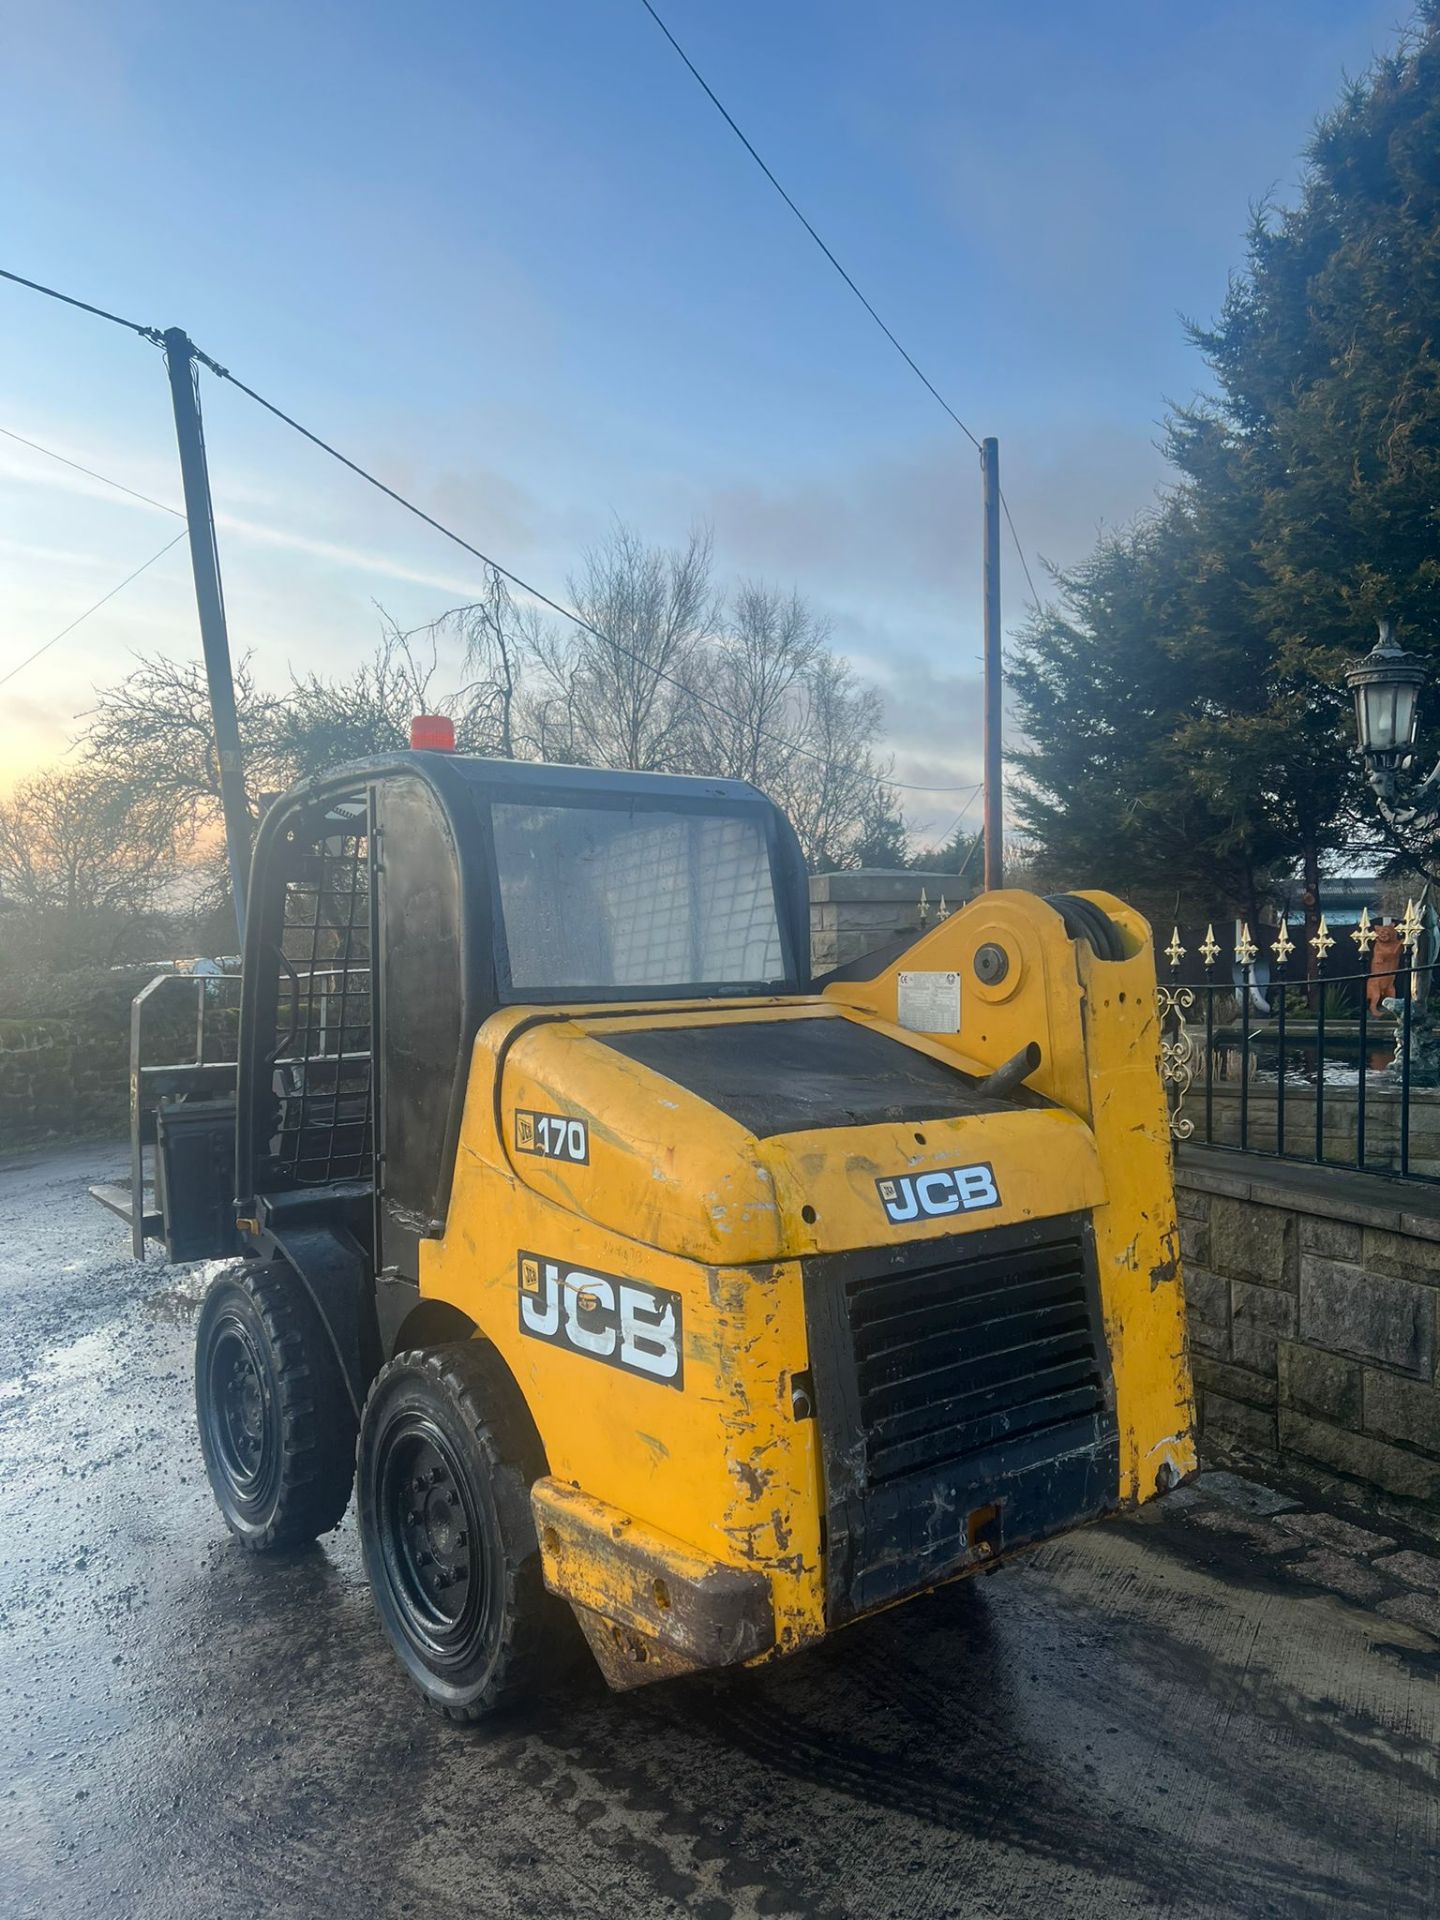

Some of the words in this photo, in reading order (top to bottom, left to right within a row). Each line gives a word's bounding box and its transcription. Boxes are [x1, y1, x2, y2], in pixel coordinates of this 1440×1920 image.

[538, 1117, 586, 1160] 170
[886, 1166, 998, 1220] JCB
[521, 1264, 678, 1378] JCB
